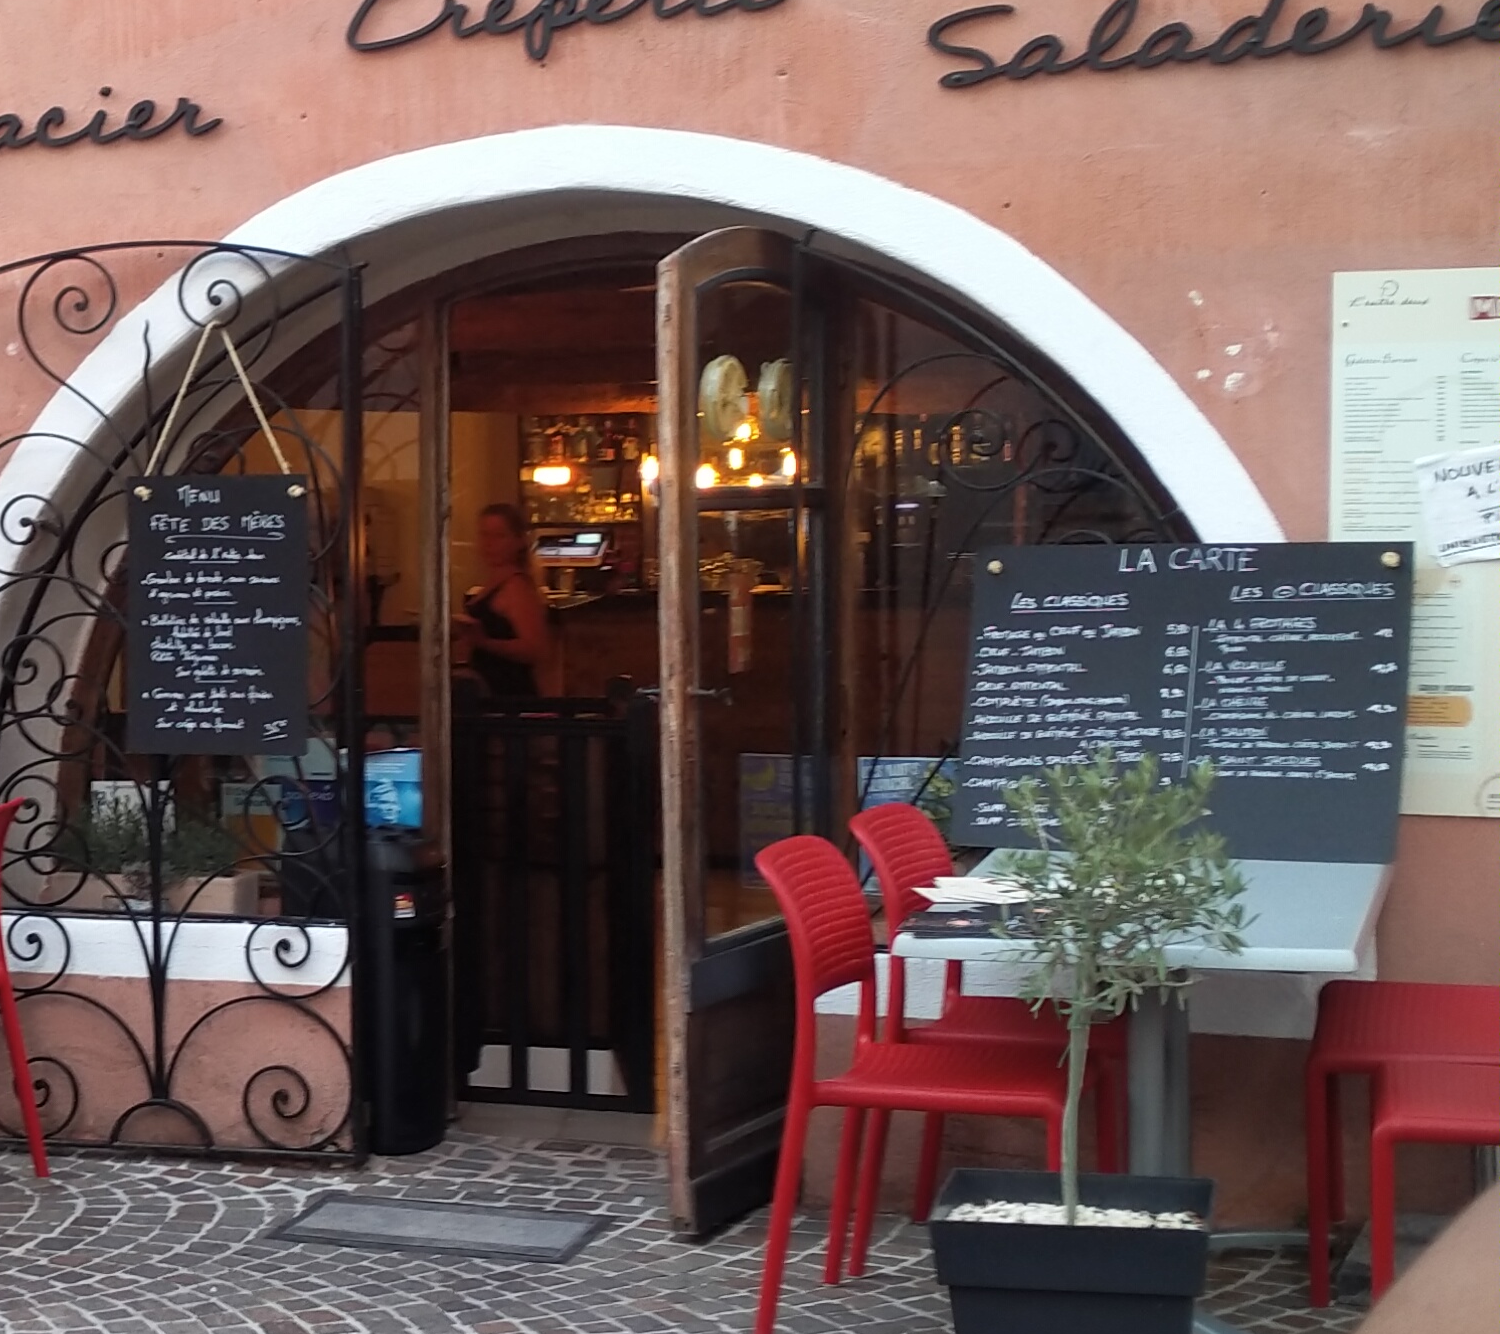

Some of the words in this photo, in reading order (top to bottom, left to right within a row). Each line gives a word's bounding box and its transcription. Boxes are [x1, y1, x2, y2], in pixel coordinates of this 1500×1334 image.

[1434, 459, 1500, 482] NOUVE
[201, 515, 231, 532] DES
[1118, 547, 1157, 573] LA
[1168, 547, 1259, 572] CARTE
[1229, 585, 1264, 601] LES
